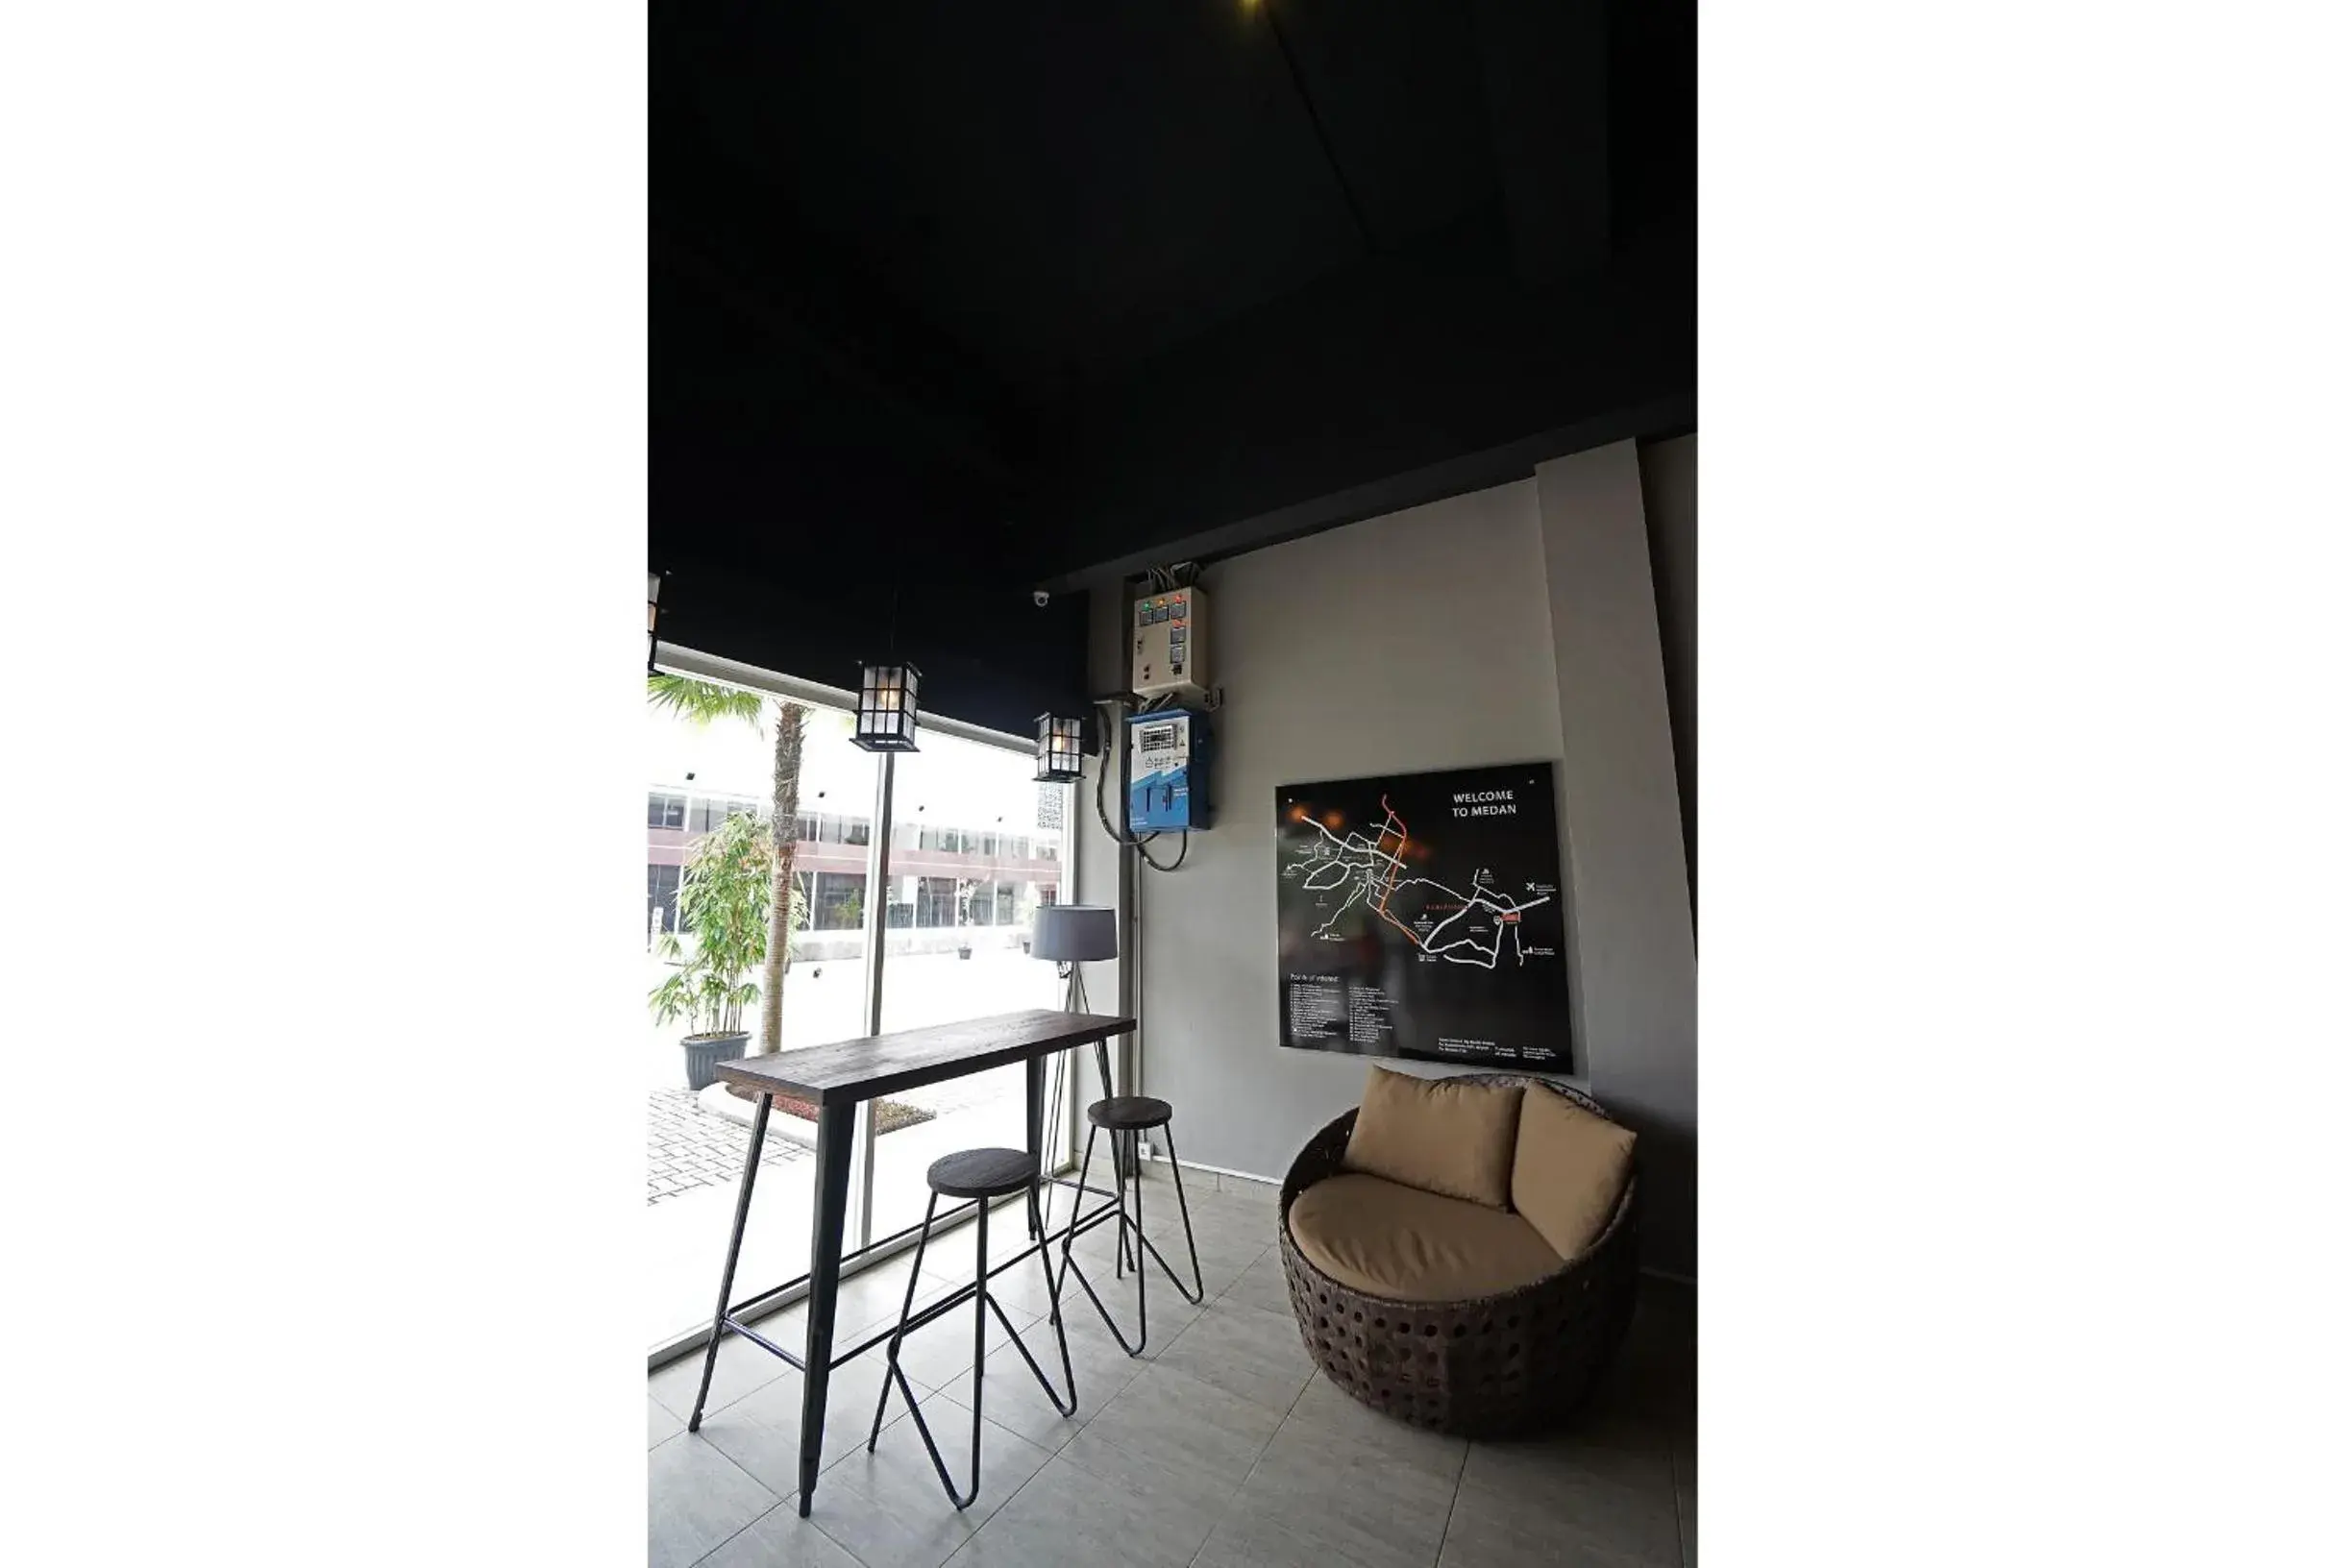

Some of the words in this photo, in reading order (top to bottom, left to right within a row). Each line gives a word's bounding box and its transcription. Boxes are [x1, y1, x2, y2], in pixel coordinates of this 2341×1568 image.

[1452, 790, 1514, 803] WELCOME
[1452, 807, 1468, 818] TO
[1470, 804, 1516, 817] MEDAN
